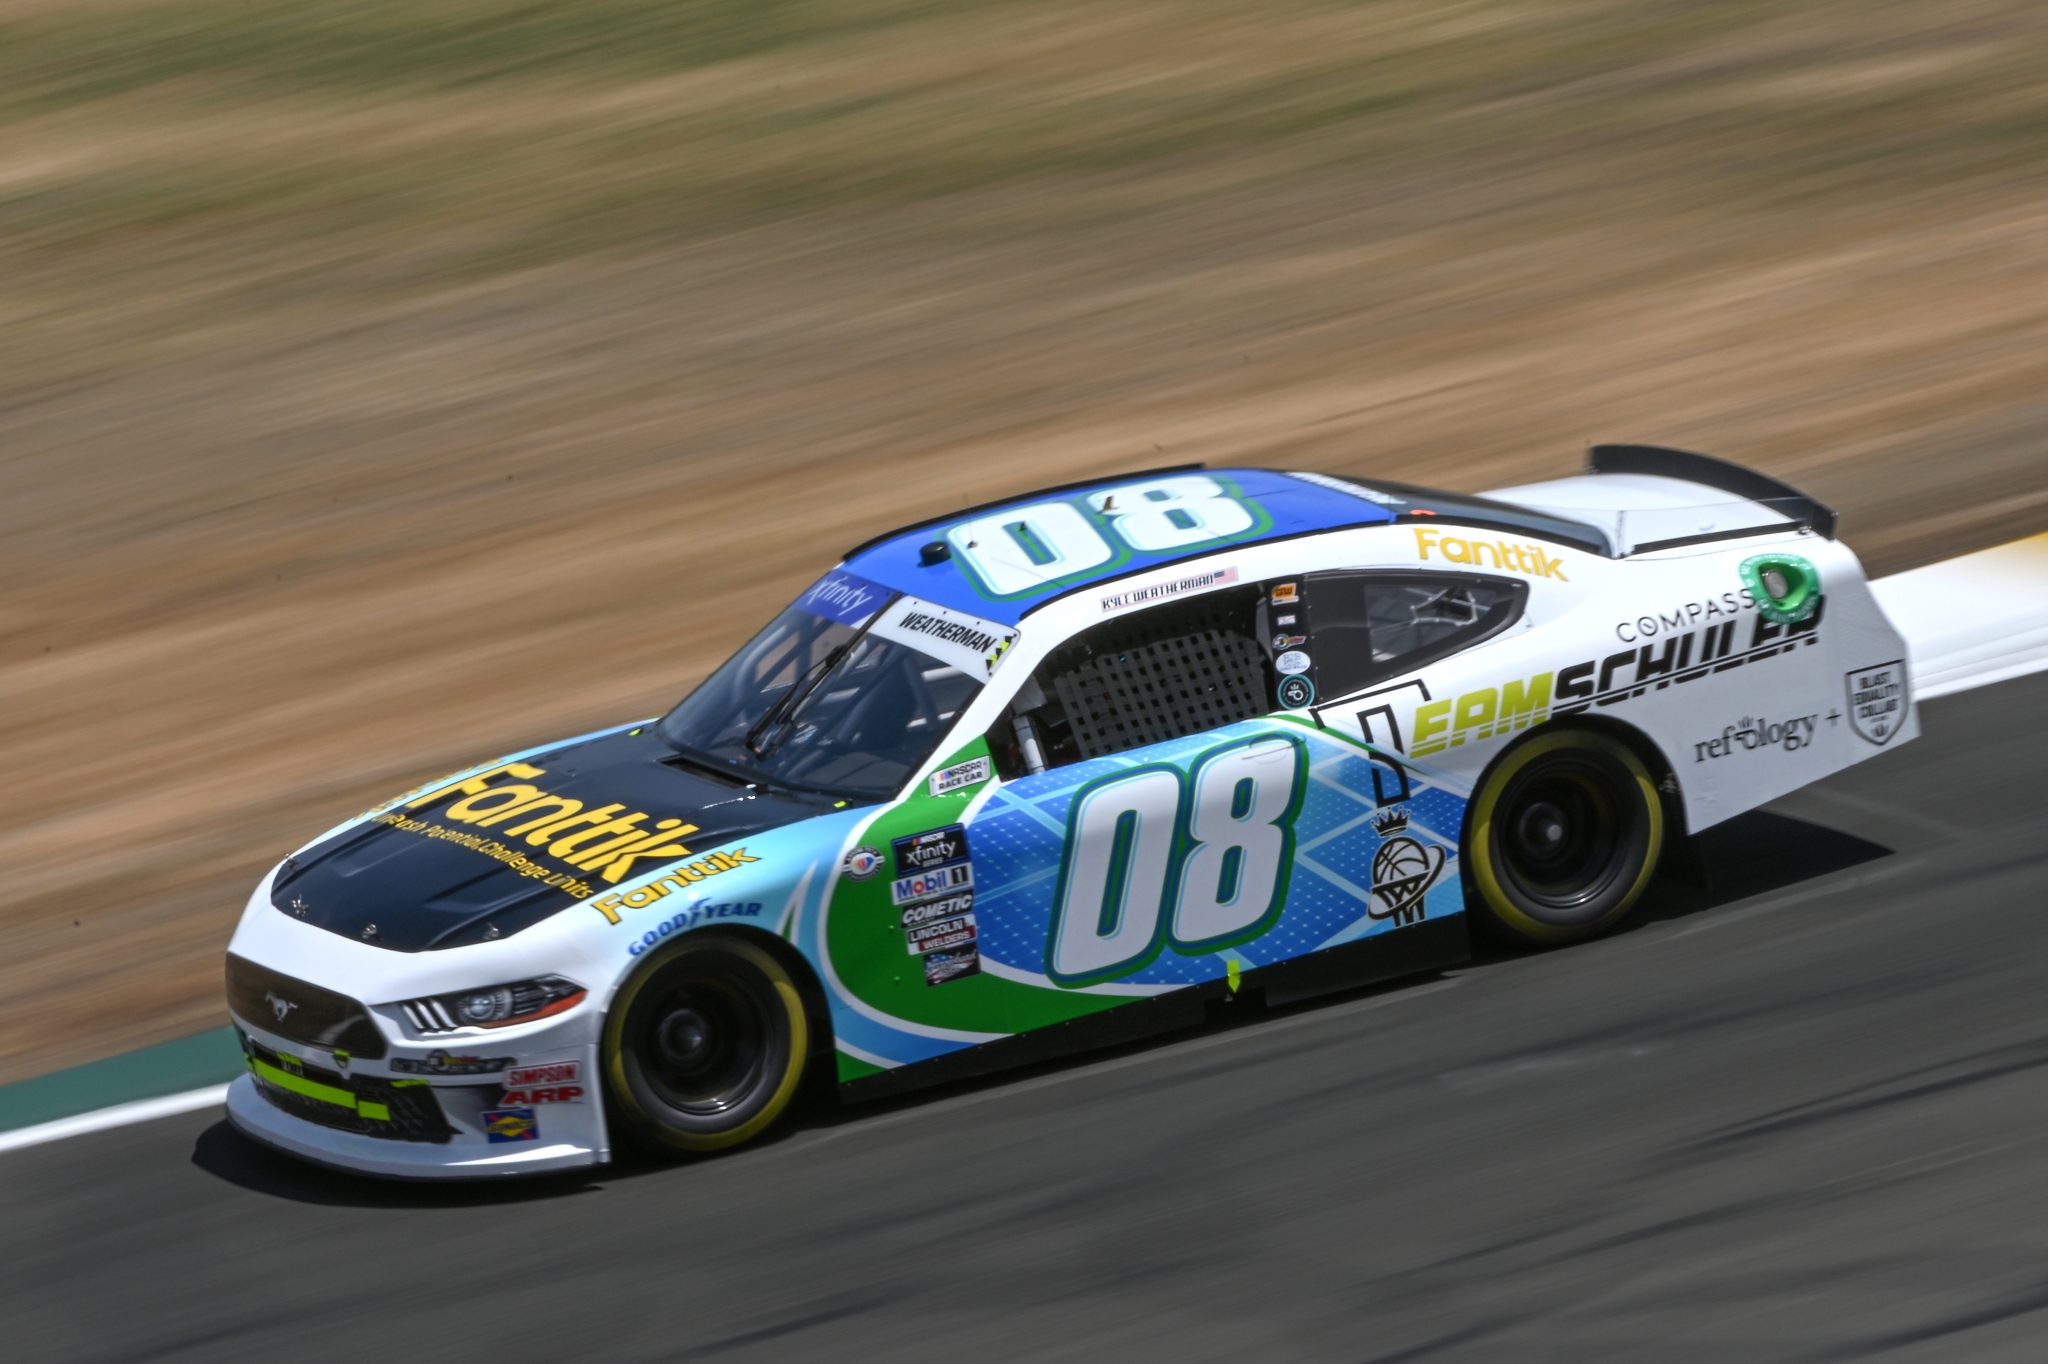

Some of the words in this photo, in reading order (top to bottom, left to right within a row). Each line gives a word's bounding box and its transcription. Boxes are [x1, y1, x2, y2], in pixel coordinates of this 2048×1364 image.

[941, 473, 1265, 598] 08
[1412, 527, 1570, 582] Fanttik
[809, 577, 872, 615] xfinity
[1102, 594, 1131, 611] KYLE
[1134, 573, 1215, 603] WEATHERMAN
[898, 611, 997, 654] WEATHERMAN
[1616, 589, 1755, 644] COMPASS
[939, 777, 962, 790] RACE
[964, 771, 983, 784] CAR
[948, 761, 982, 778] NASCAR
[405, 762, 700, 883] Fanttik
[906, 842, 956, 866] xfinity
[1048, 734, 1306, 986] 08
[592, 847, 762, 926] Fanttik
[896, 871, 948, 899] Mobil
[903, 895, 973, 923] COMETIC
[910, 920, 963, 942] LINCOLN
[924, 931, 969, 949] WELDERS
[510, 1065, 575, 1086] SIMPSON
[502, 1086, 584, 1104] ARP
